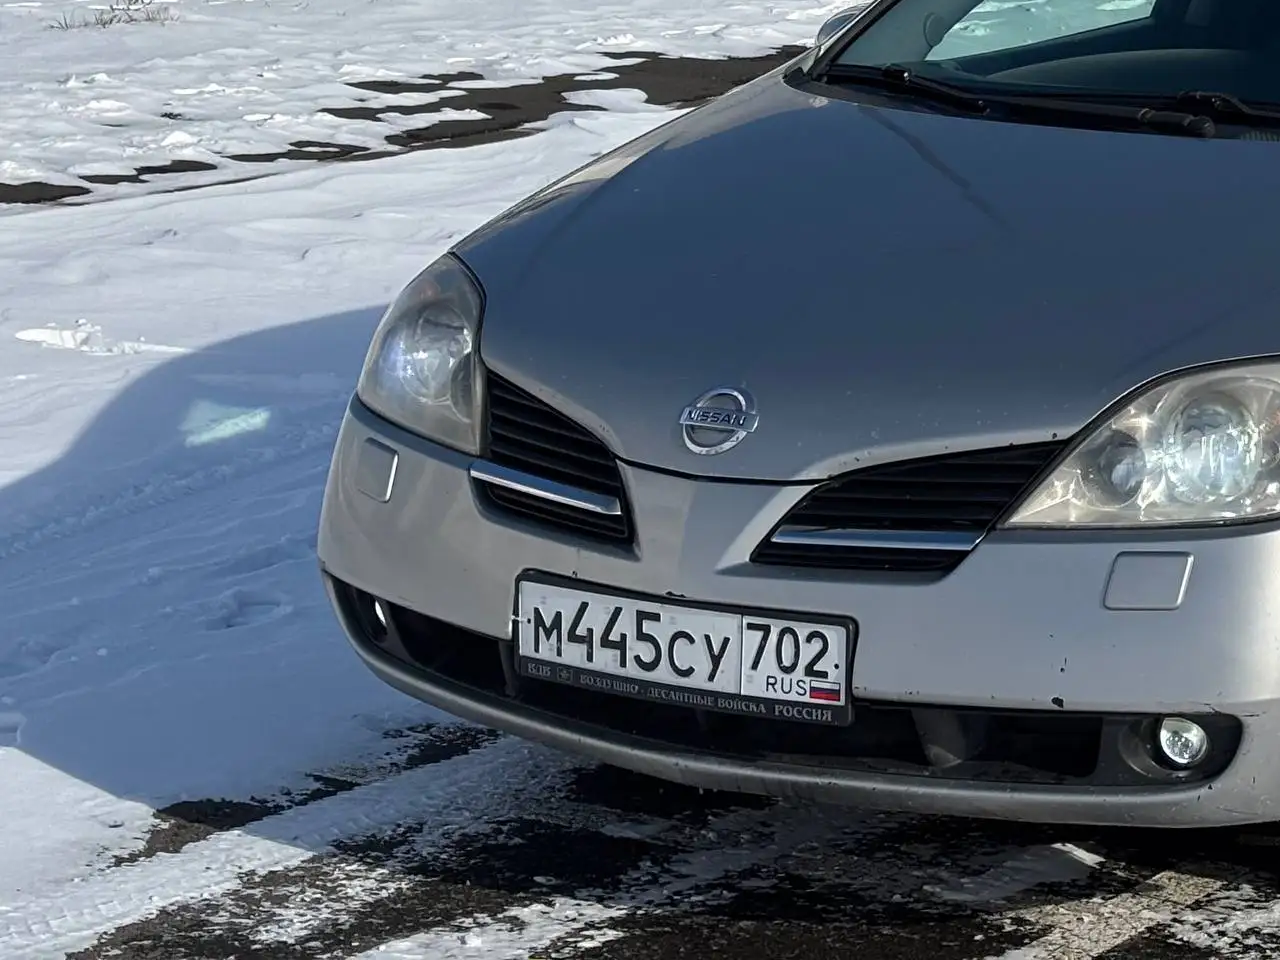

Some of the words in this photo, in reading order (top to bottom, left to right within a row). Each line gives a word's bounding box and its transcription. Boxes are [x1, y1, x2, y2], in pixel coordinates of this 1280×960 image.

[687, 409, 747, 426] NISSAN
[746, 622, 829, 680] 702
[580, 674, 639, 694] ВОЗДУШНО
[646, 687, 715, 706] ДЕСАНТНЫЕ
[717, 698, 767, 714] ВОЙСКА
[774, 704, 833, 722] РОССИЯ
[765, 675, 807, 696] RUS
